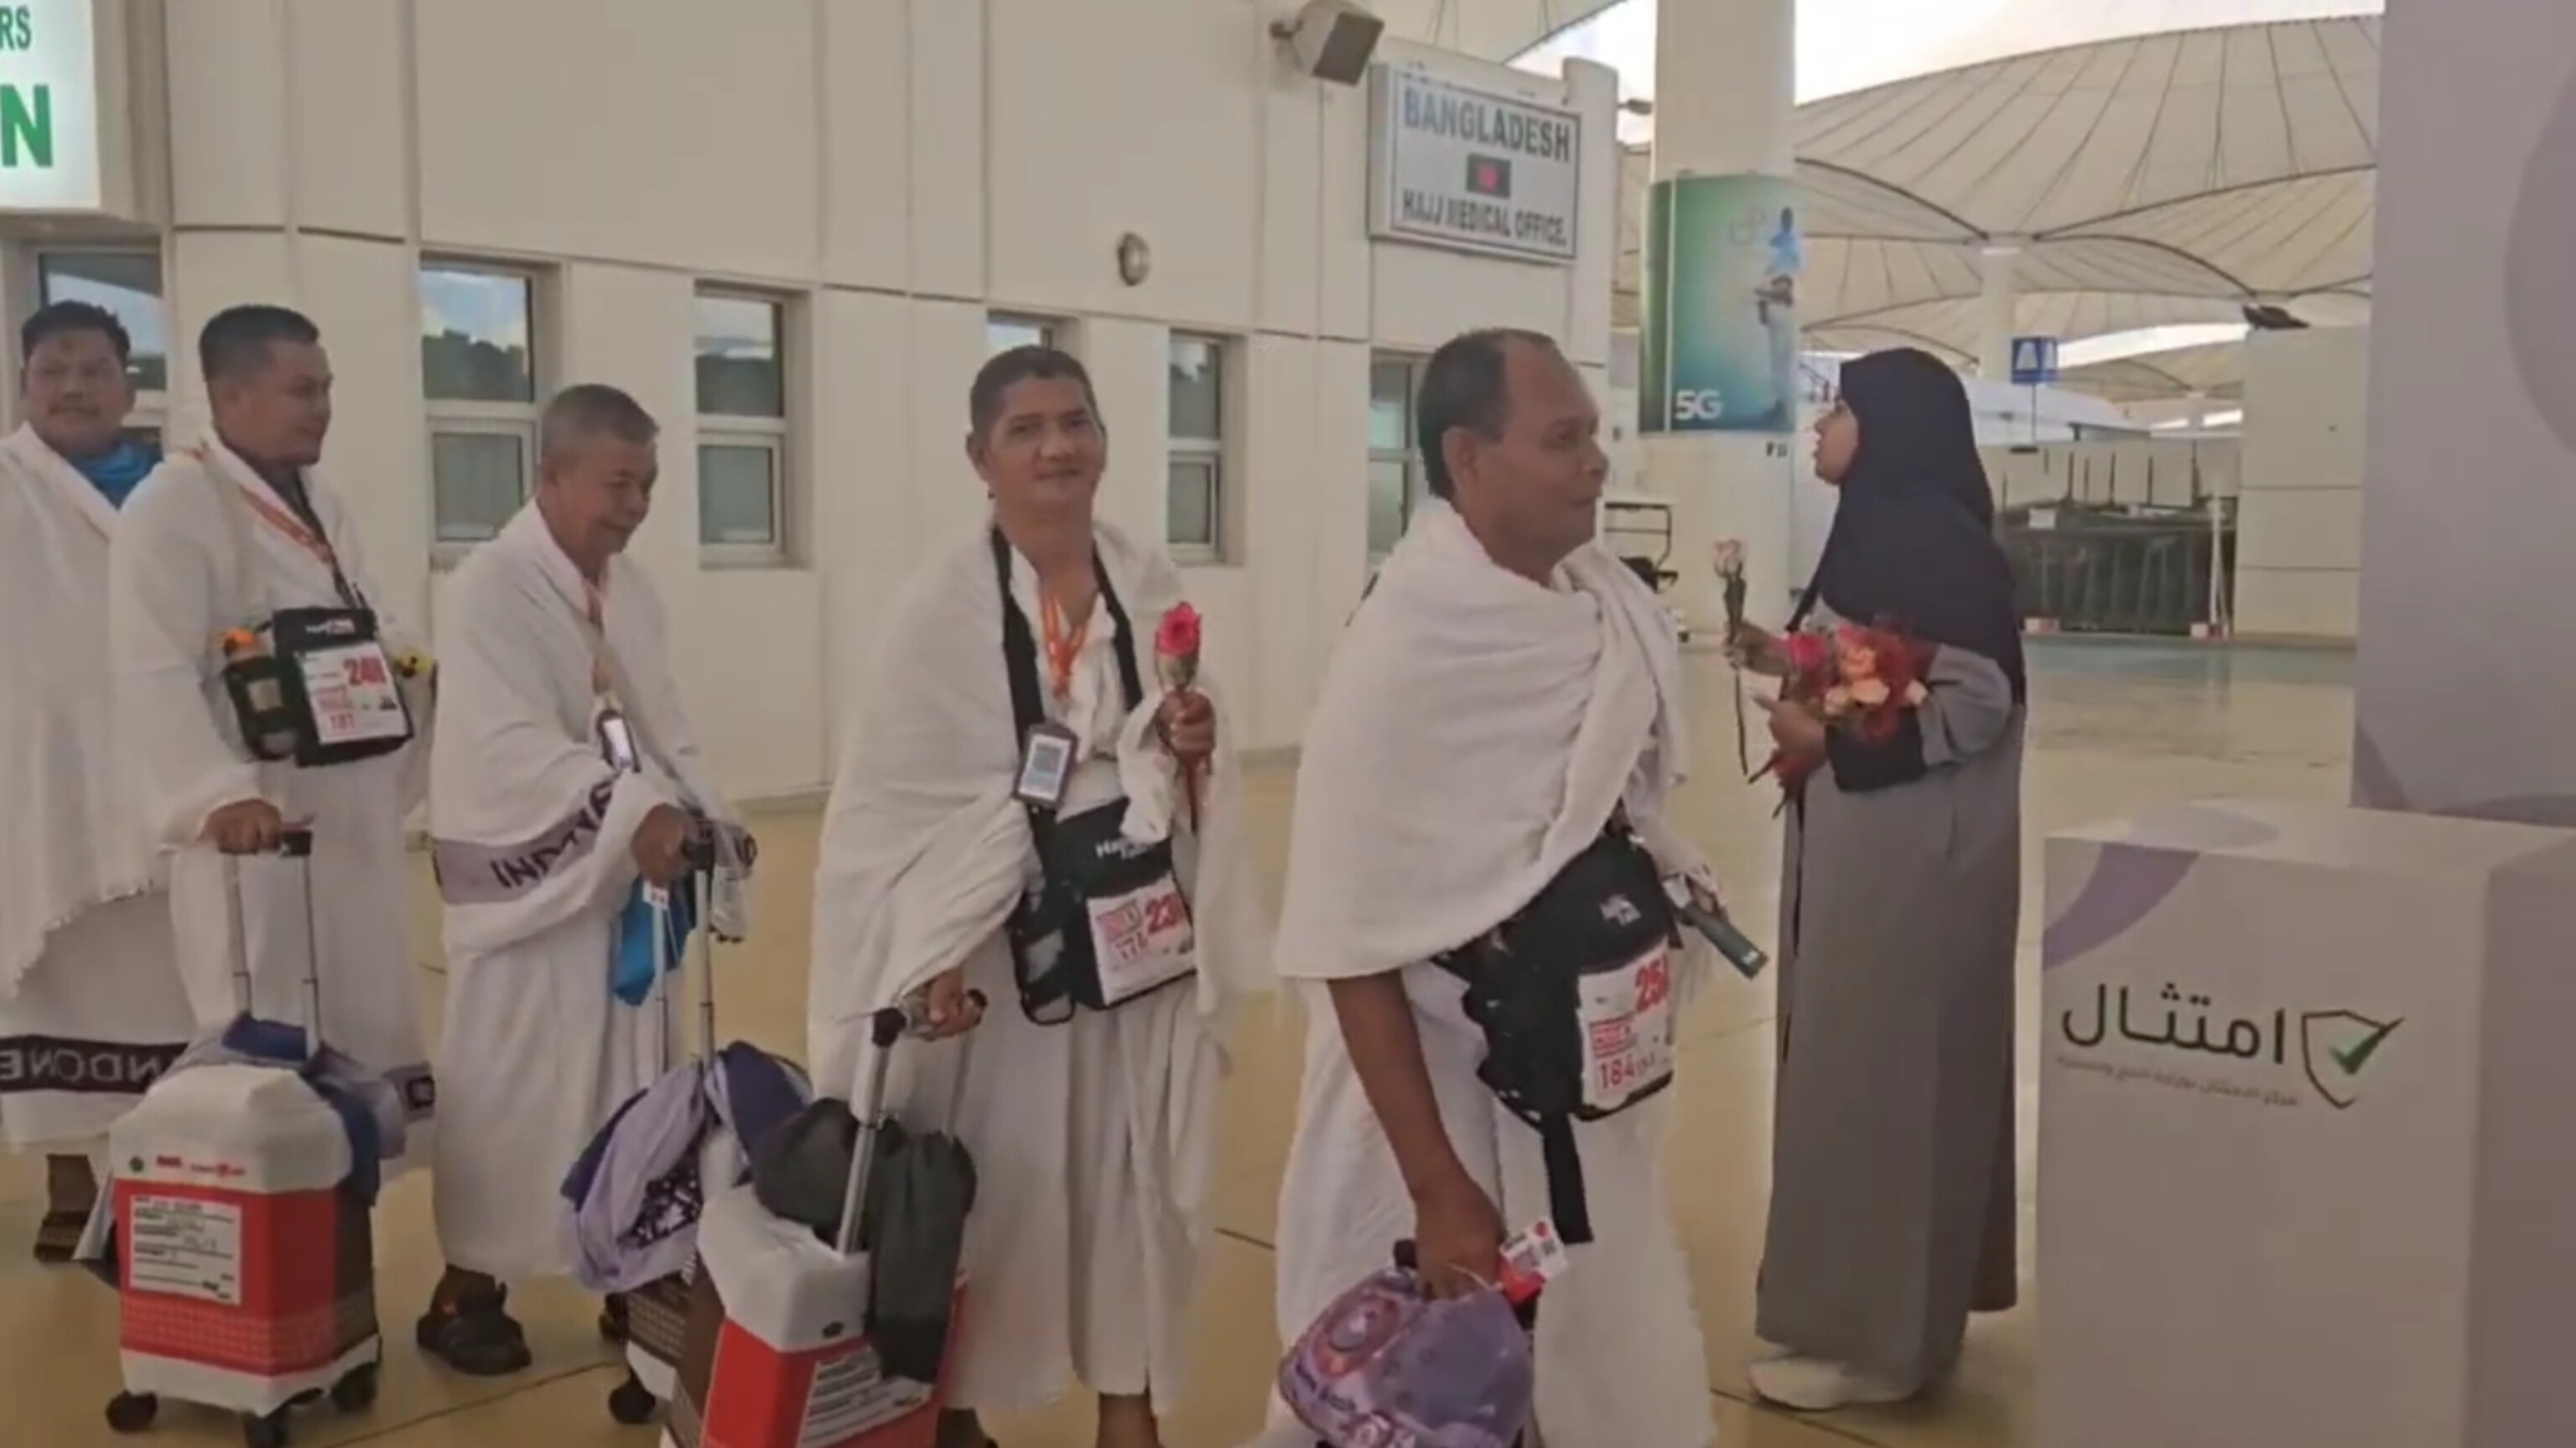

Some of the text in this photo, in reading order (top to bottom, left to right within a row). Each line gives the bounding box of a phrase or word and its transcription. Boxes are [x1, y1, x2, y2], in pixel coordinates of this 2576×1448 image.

[1405, 85, 1571, 163] BANGLADESH
[1402, 188, 1445, 226] HAJJ
[1446, 196, 1511, 238] MEDICAL
[1674, 388, 1723, 421] 5G
[2061, 982, 2285, 1065] امتثال
